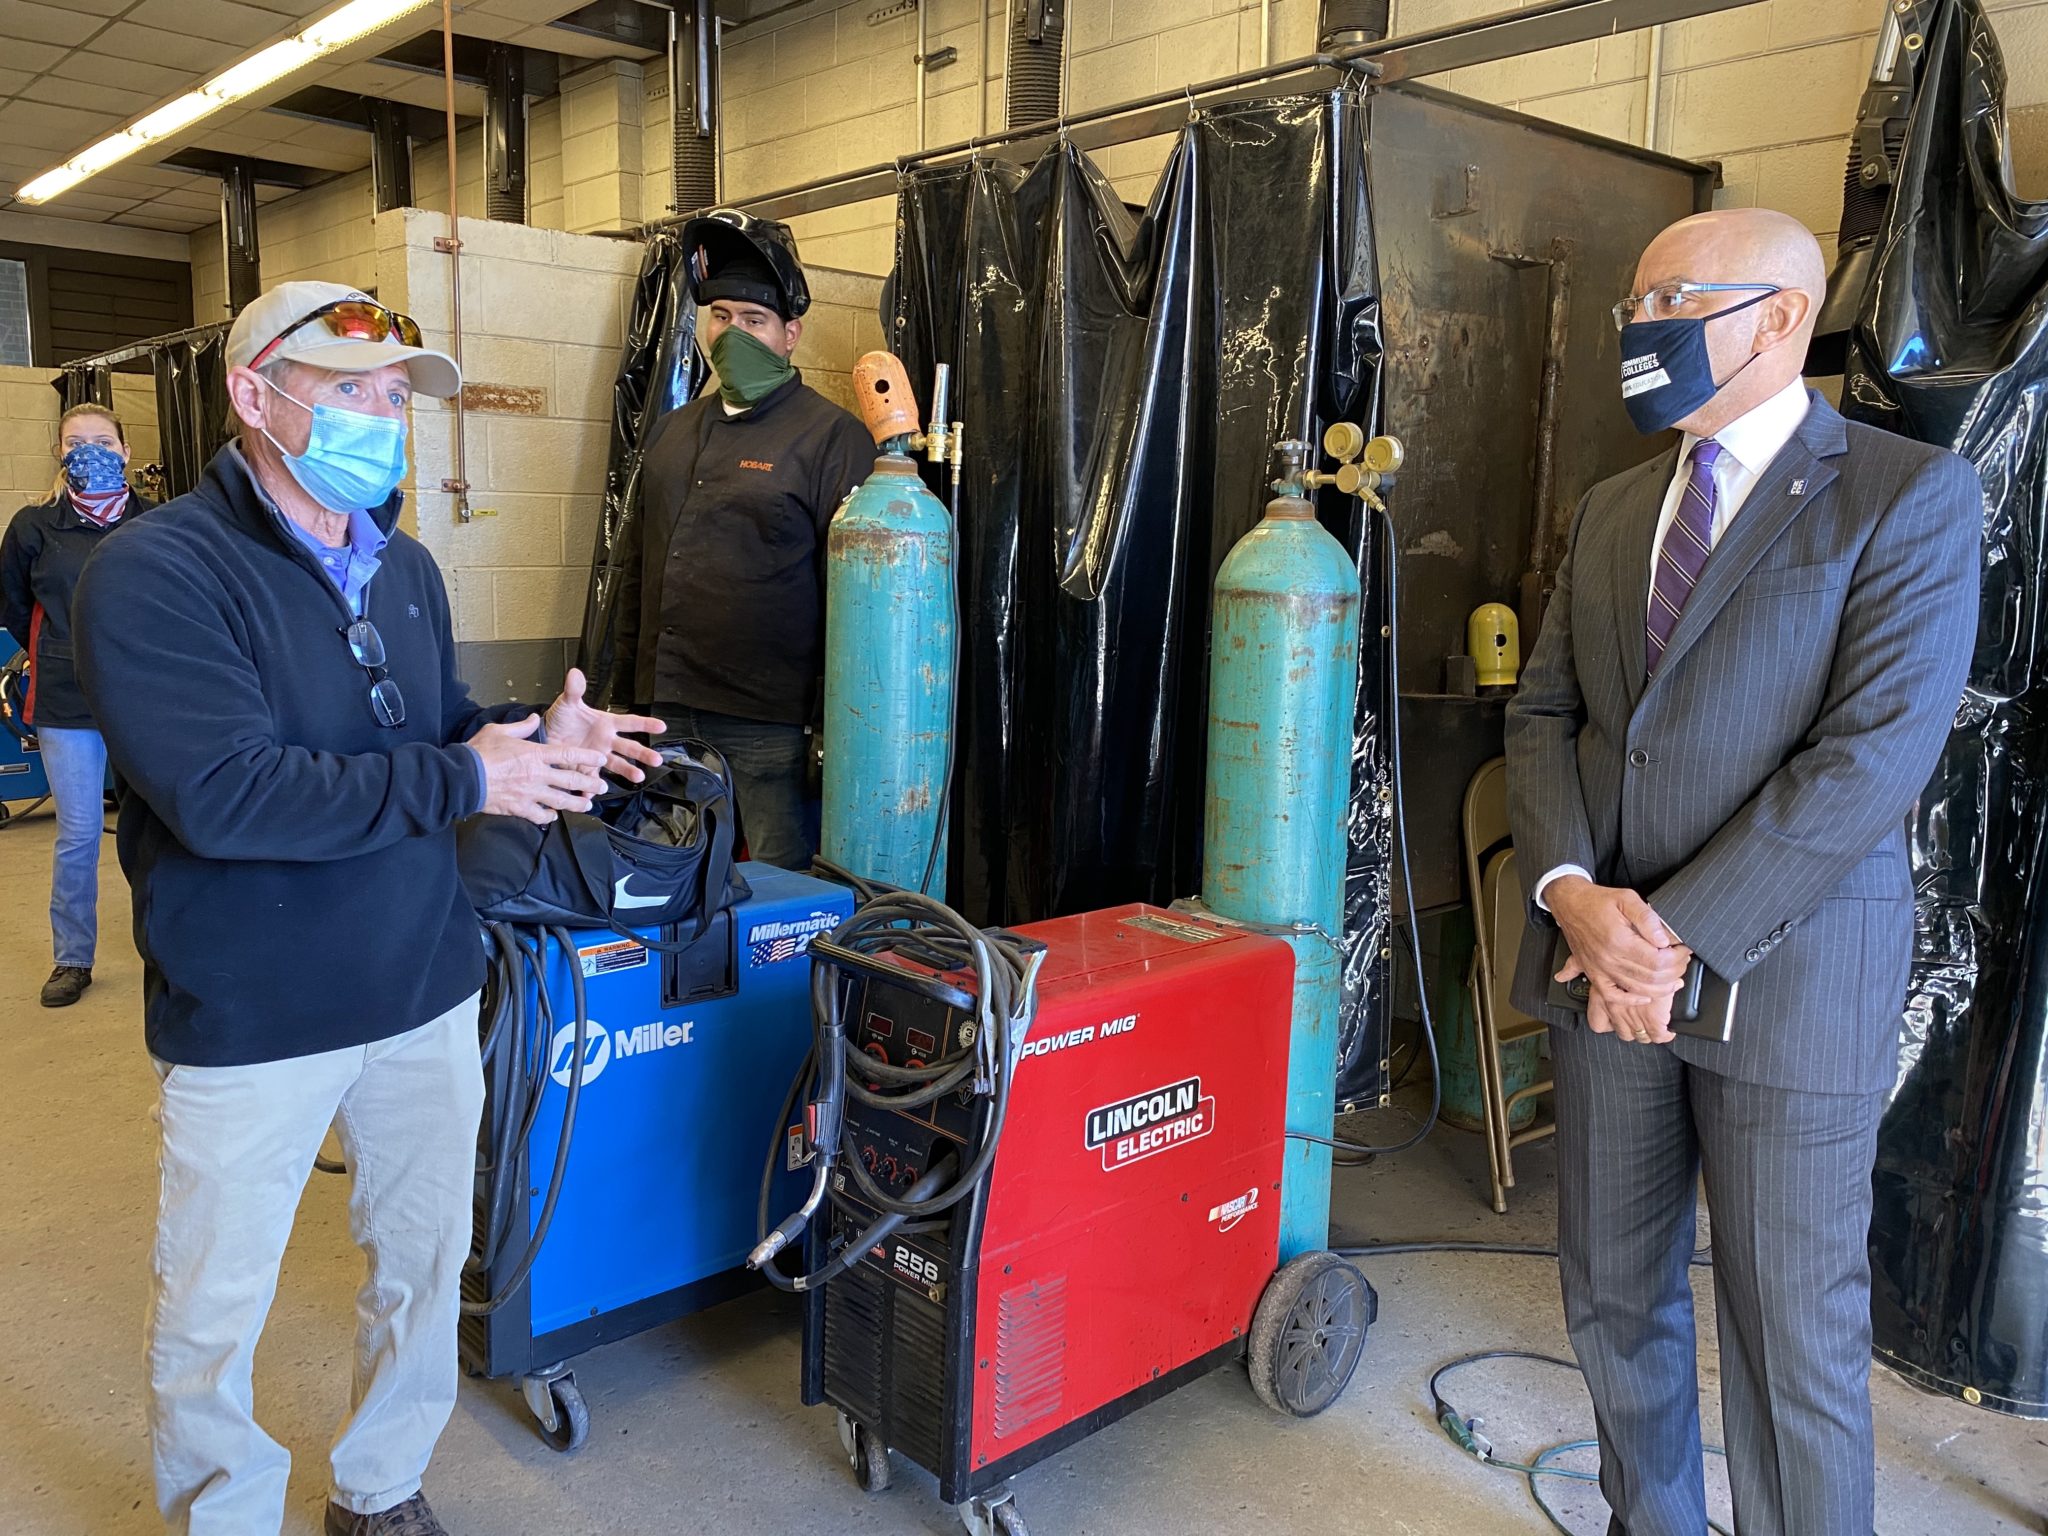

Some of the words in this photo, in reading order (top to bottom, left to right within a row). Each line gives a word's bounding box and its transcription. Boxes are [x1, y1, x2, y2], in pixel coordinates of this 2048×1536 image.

[1622, 352, 1658, 369] COMMUNITY
[1623, 359, 1660, 377] COLLEGES
[740, 460, 774, 471] HOBART
[749, 912, 840, 943] Millermatic
[604, 942, 630, 952] WARNING
[615, 1021, 694, 1059] Miller
[1020, 1026, 1095, 1060] POWER
[1099, 1015, 1137, 1038] MIG
[1092, 1084, 1194, 1142] LINCOLN
[1116, 1113, 1204, 1161] ELECTRIC
[893, 1262, 921, 1281] POWER
[895, 1245, 939, 1281] 256
